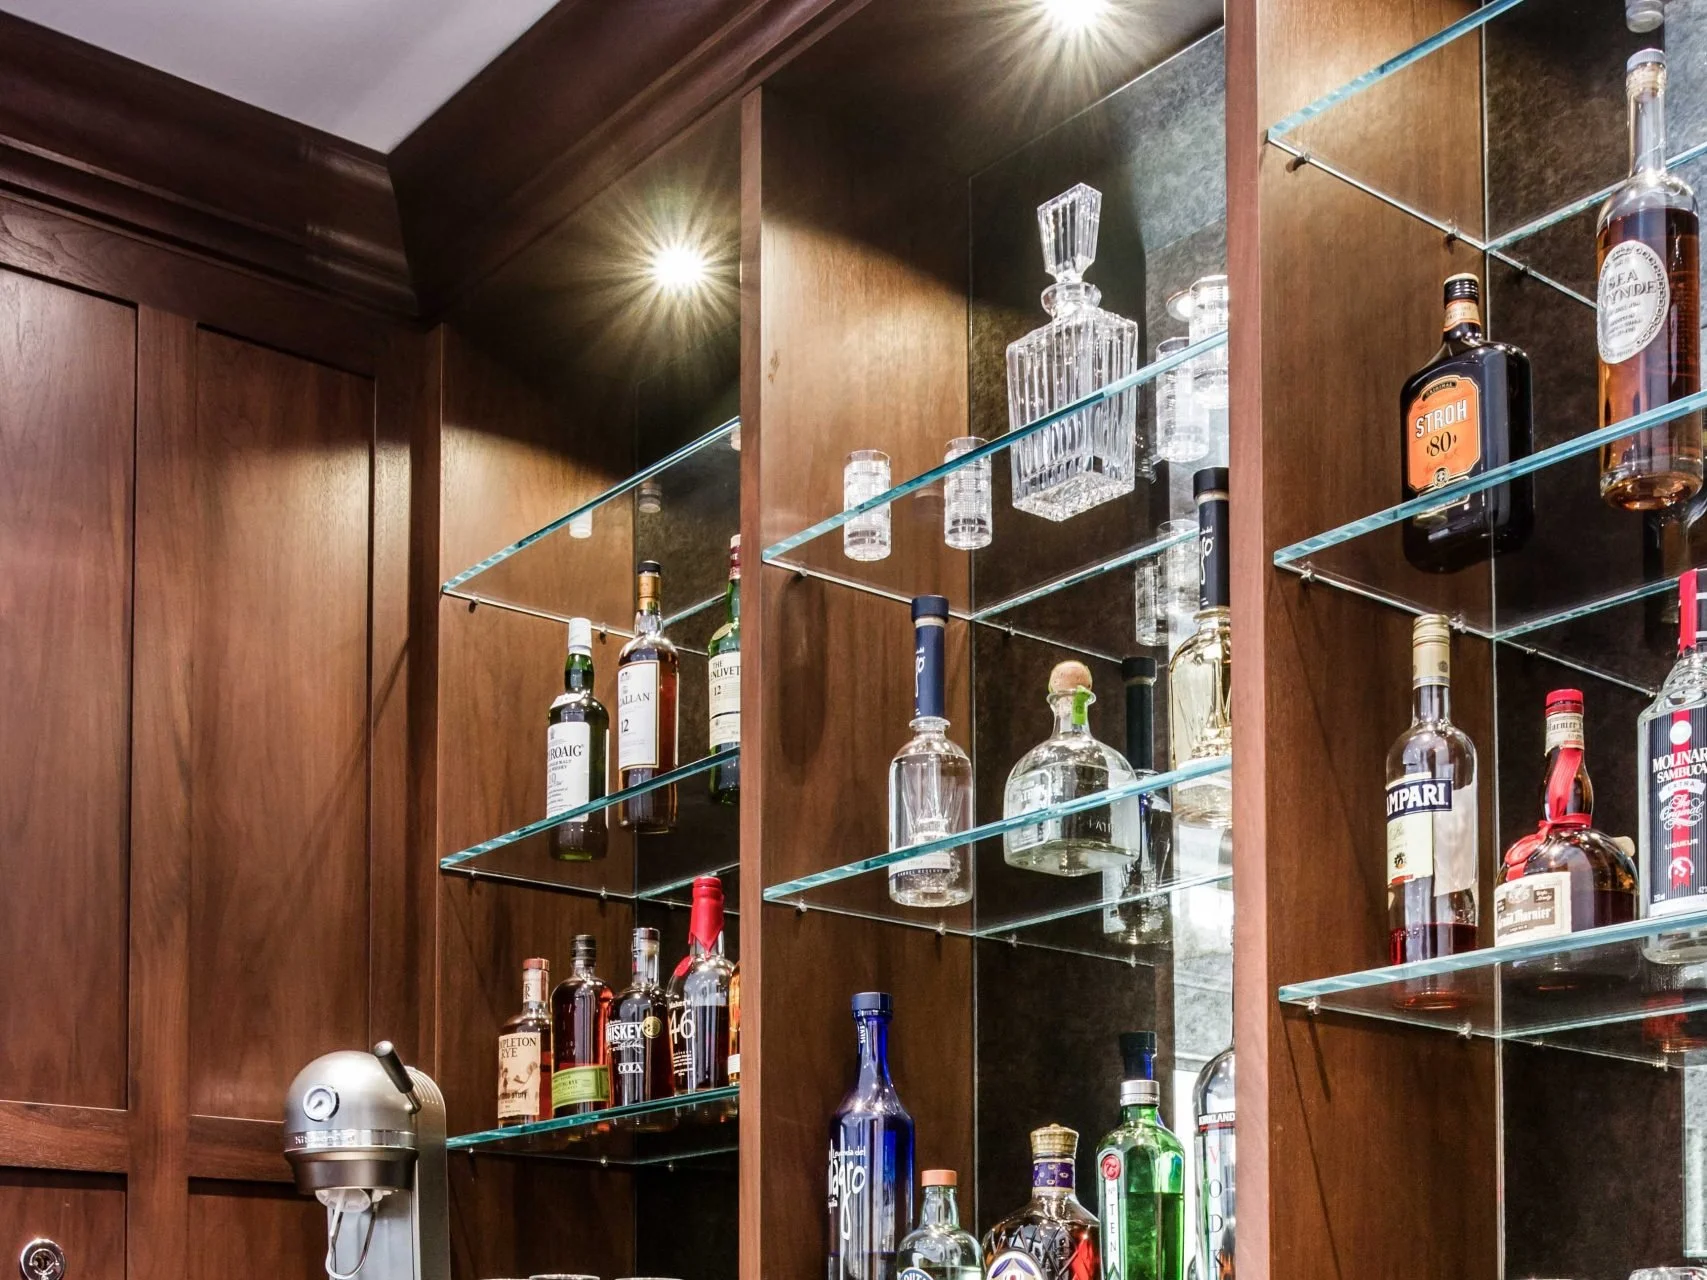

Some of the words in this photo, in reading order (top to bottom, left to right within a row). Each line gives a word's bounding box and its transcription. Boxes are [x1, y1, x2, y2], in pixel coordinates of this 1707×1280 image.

[1608, 268, 1638, 290] SEA
[1415, 400, 1467, 438] STROH
[713, 660, 722, 669] THE
[714, 685, 721, 696] 12
[621, 718, 629, 733] 12
[1665, 838, 1699, 850] LIQUEUR
[669, 1009, 696, 1045] 46
